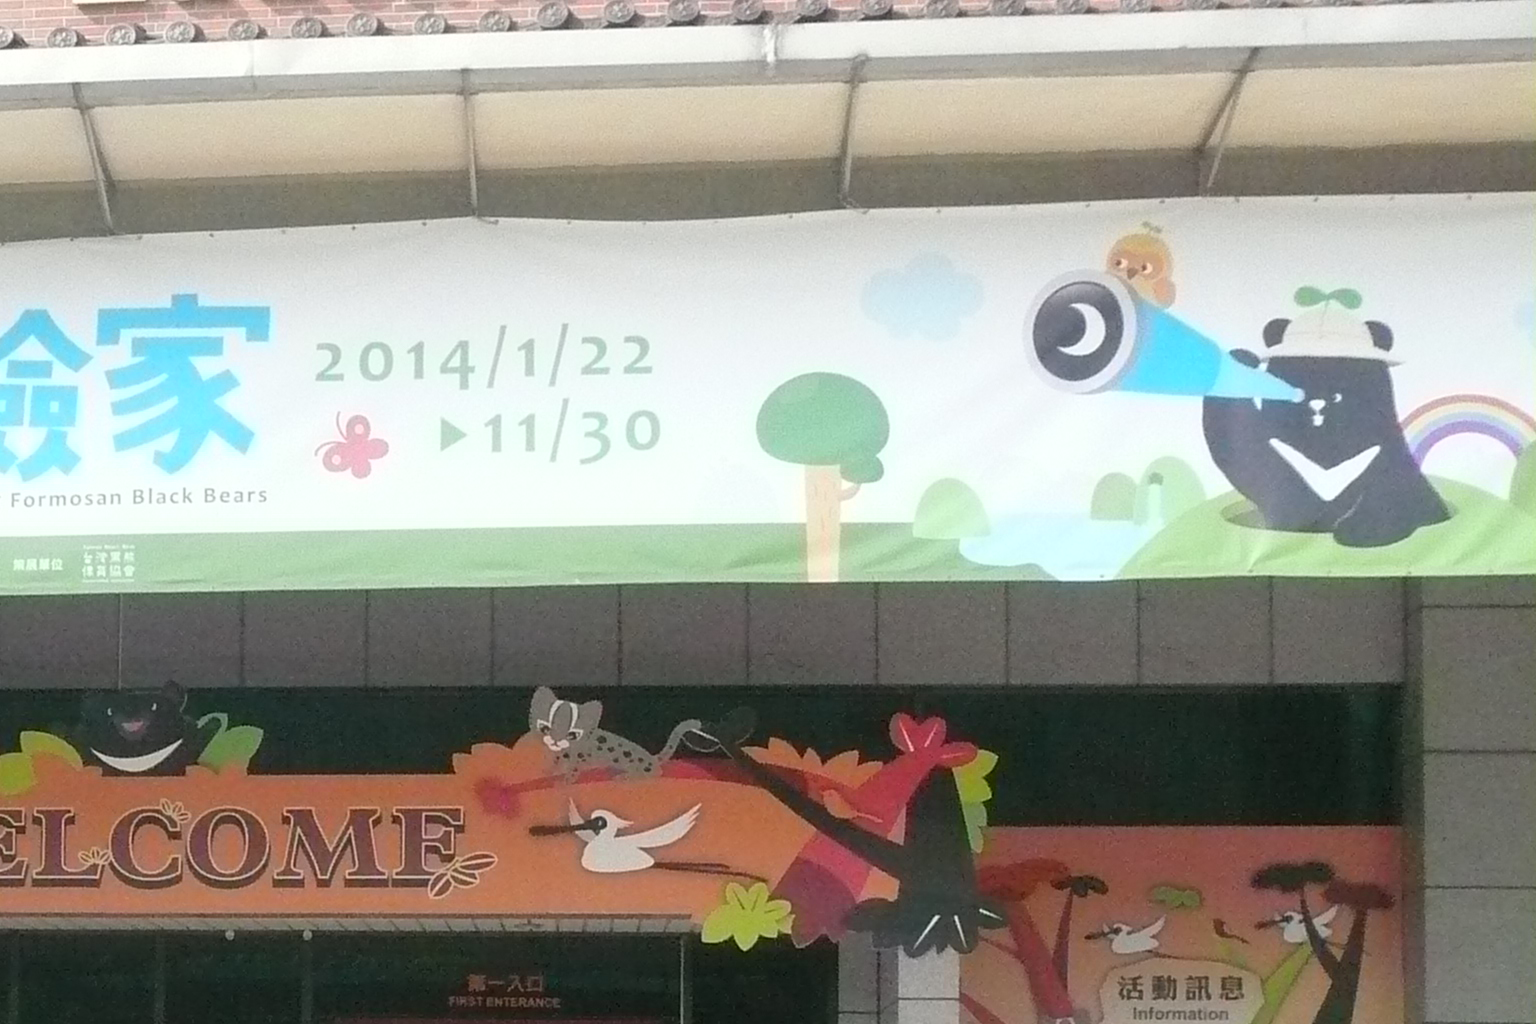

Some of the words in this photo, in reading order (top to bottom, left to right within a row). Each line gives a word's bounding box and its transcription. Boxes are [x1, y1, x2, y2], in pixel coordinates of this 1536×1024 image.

[314, 322, 654, 391] 2014/1/22
[10, 491, 123, 509] Formosan
[132, 487, 194, 505] Black
[203, 486, 269, 504] Bears
[467, 974, 544, 992] 第一入口
[1117, 975, 1245, 1001] 活動訊息
[448, 996, 483, 1007] FIRST
[1133, 1006, 1230, 1021] Information
